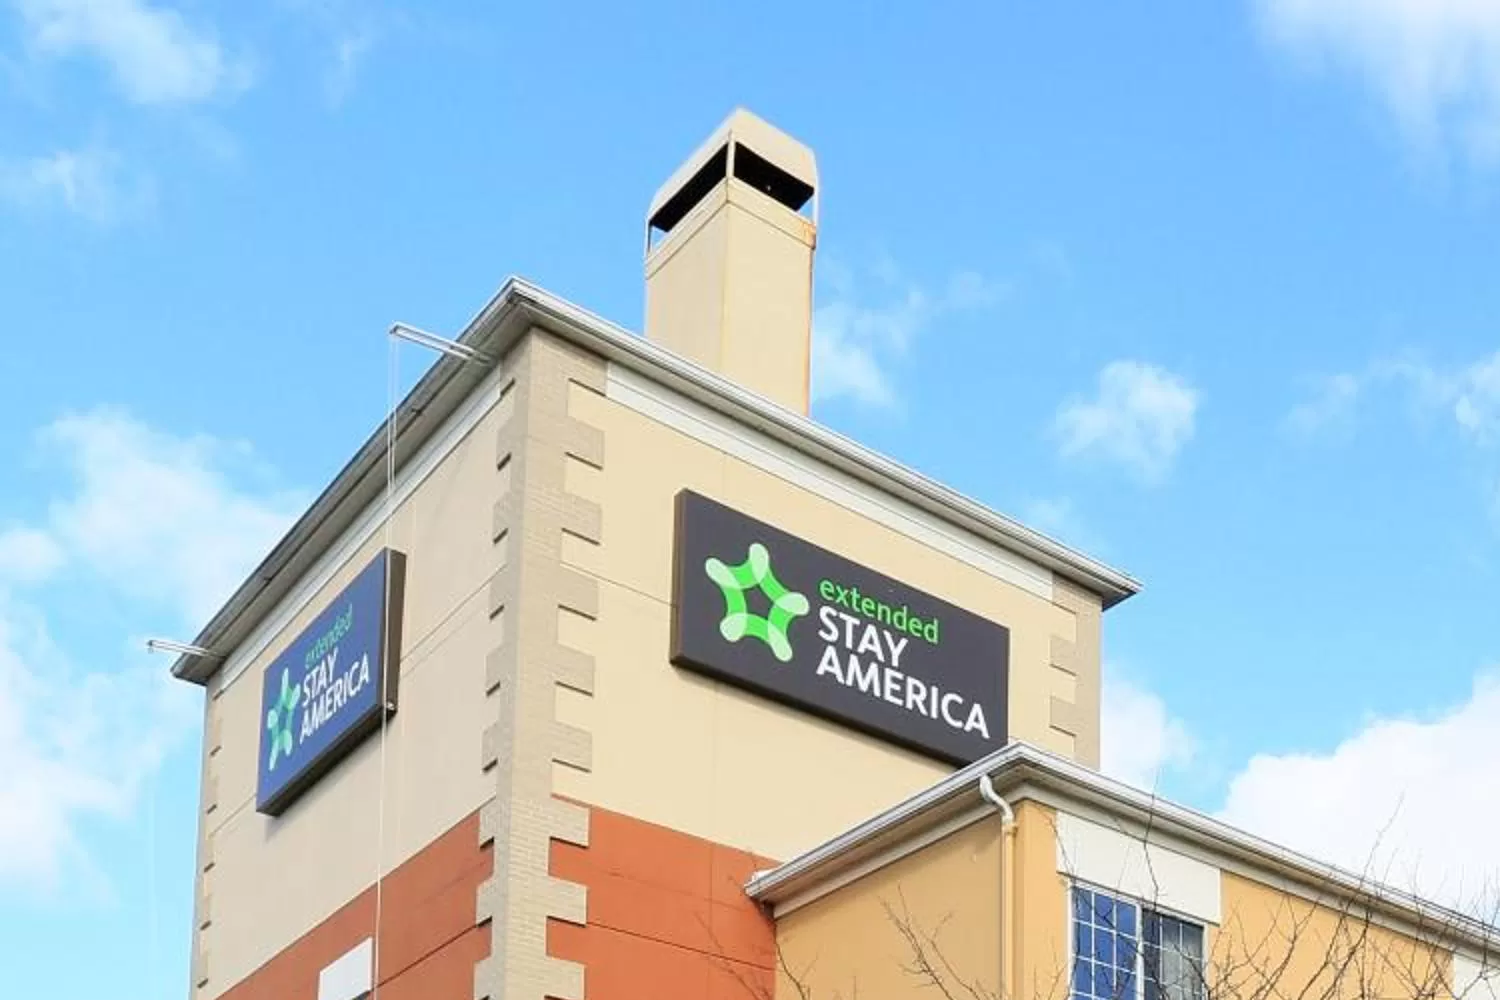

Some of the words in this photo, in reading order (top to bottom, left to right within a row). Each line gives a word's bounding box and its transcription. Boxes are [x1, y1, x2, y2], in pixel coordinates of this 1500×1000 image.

[818, 605, 908, 668] STAY
[819, 579, 939, 644] extended
[299, 652, 370, 744] AMERICA
[302, 646, 339, 707] STAY
[816, 646, 990, 739] AMERICA
